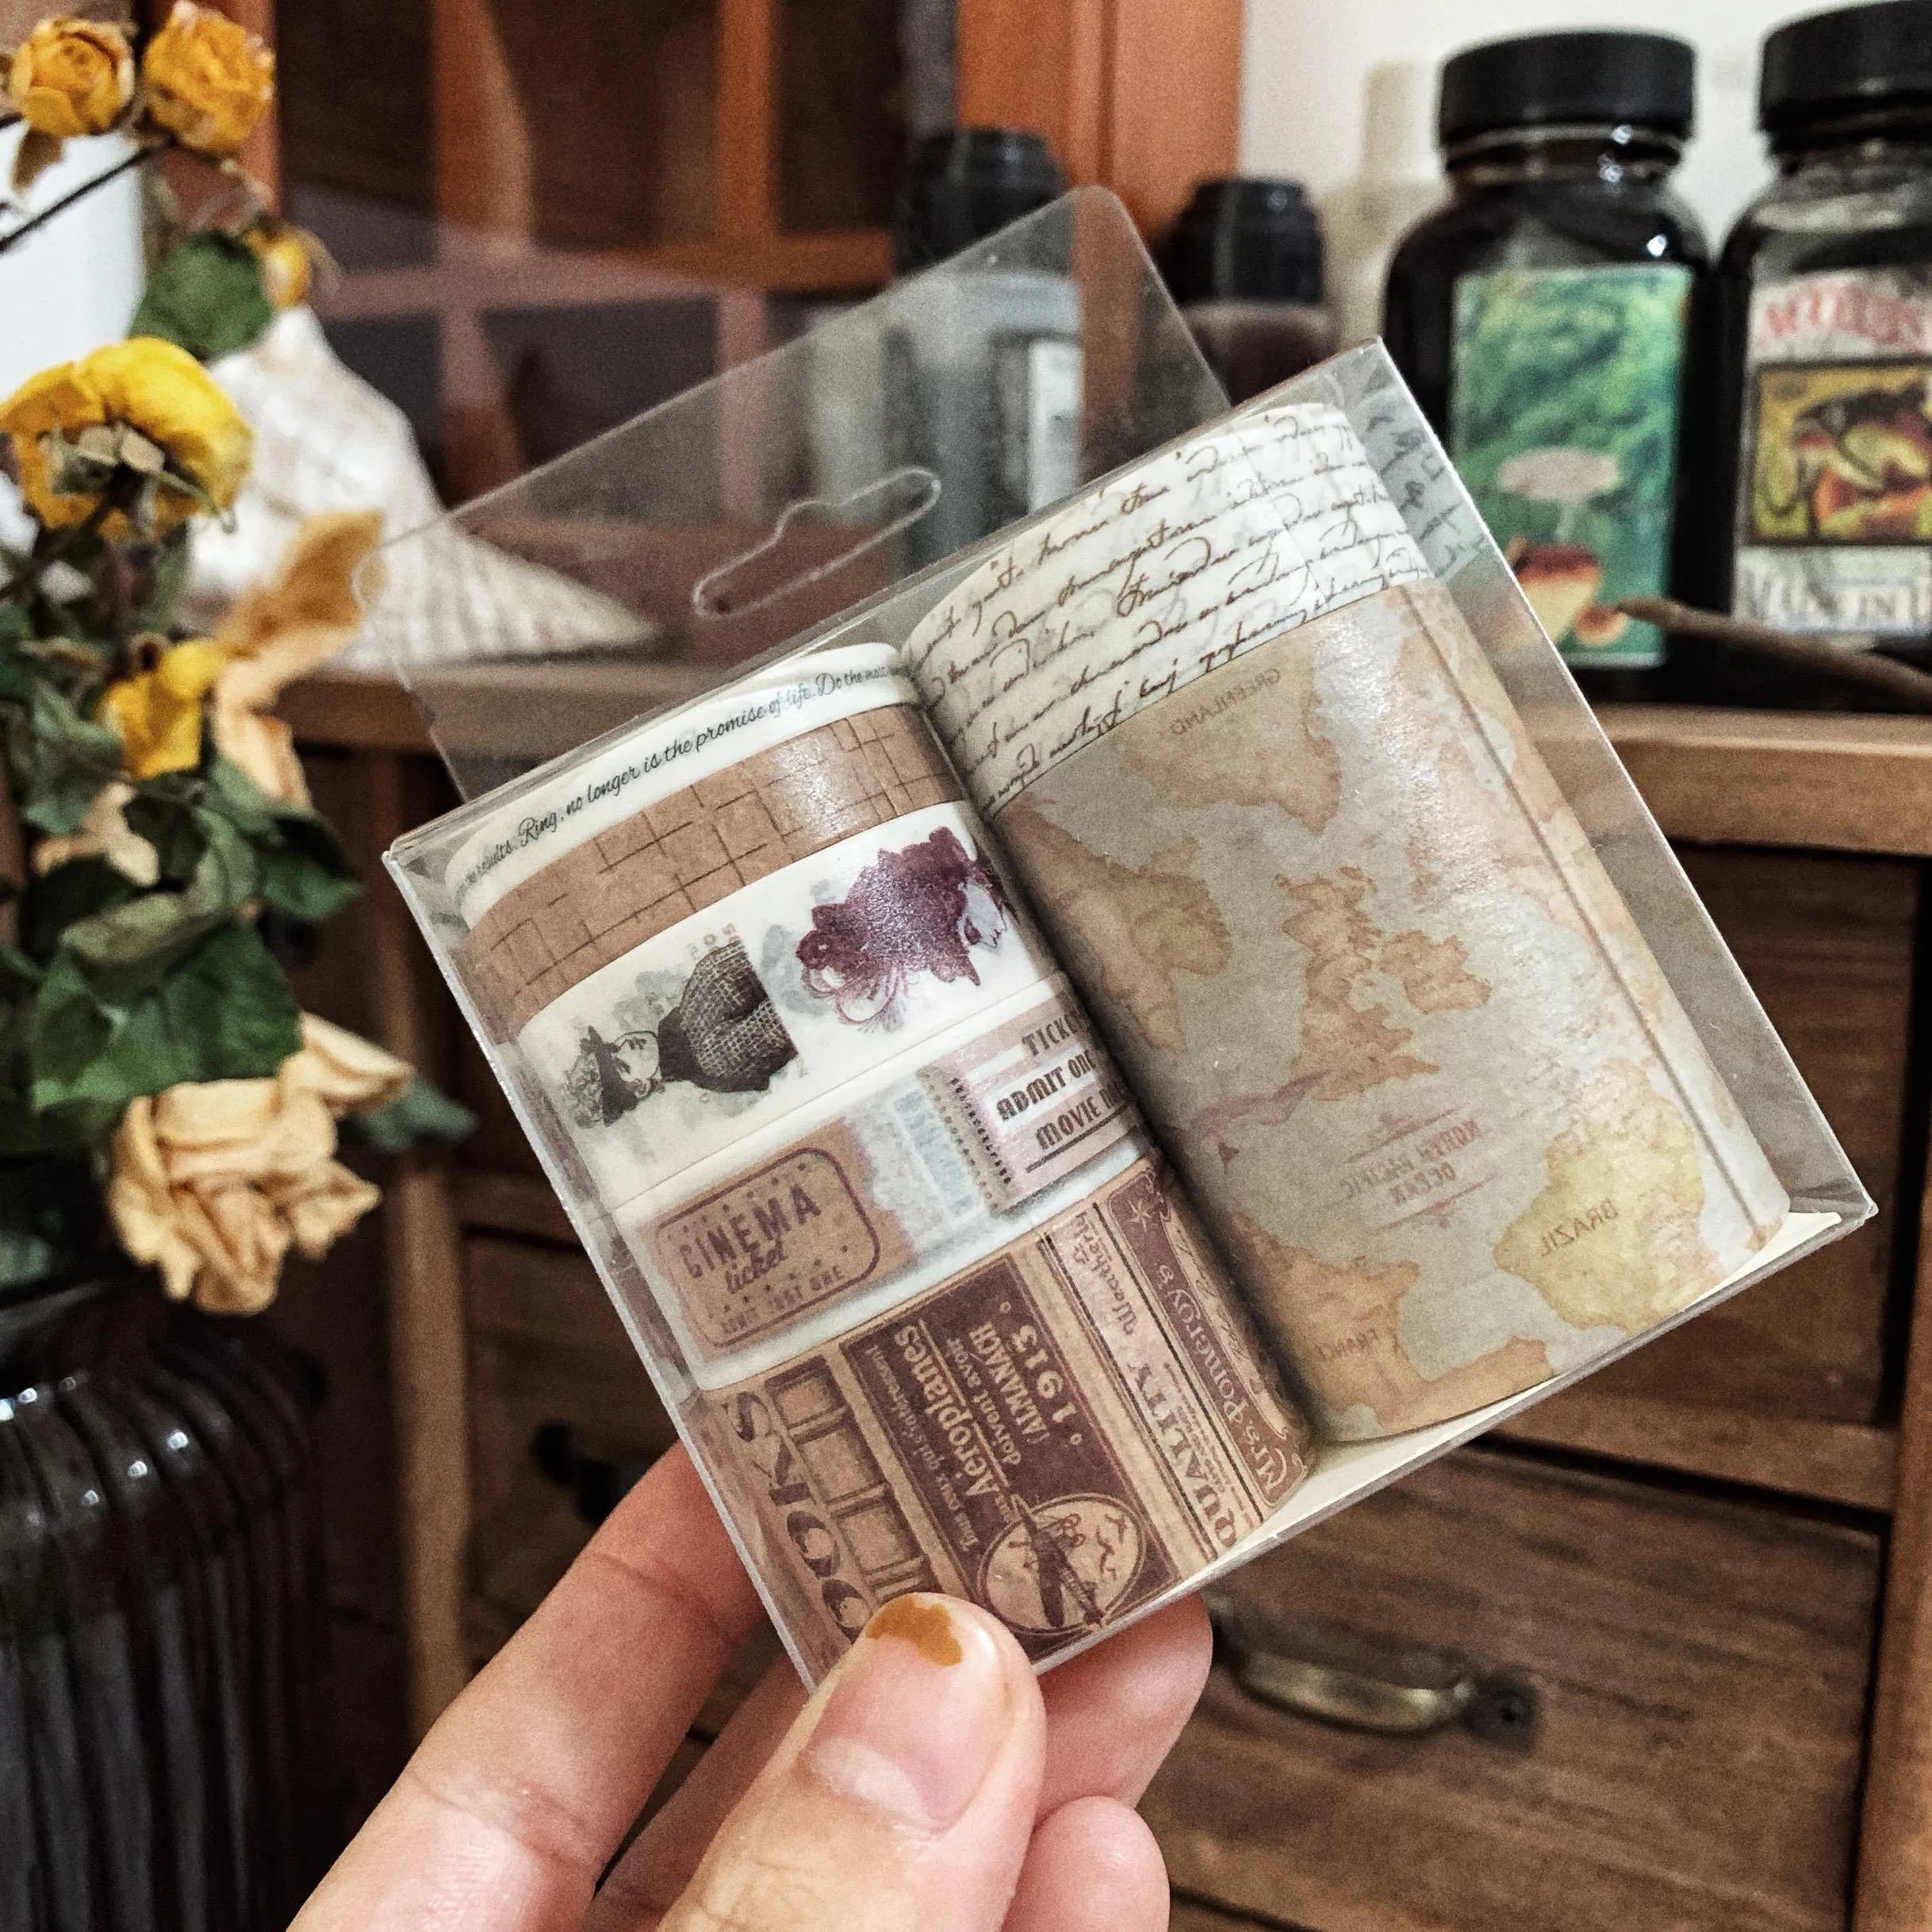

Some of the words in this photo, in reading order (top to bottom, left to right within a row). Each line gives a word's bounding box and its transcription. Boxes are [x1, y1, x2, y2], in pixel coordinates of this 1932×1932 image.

[566, 795, 583, 815] no
[588, 765, 640, 803] longer
[643, 752, 663, 772] is
[664, 734, 694, 763] the
[695, 705, 765, 753] promise
[768, 691, 783, 719] of
[815, 672, 843, 697] Do
[843, 671, 864, 688] the
[996, 1066, 1068, 1121] ADMIT
[1035, 1095, 1102, 1152] MOVIE
[678, 1183, 822, 1280] CINEMA
[724, 1234, 789, 1295] ticket
[1073, 1210, 1138, 1336] Weatherly
[945, 1336, 983, 1389] avoir
[1011, 1324, 1077, 1424] 1913
[1156, 1263, 1245, 1425] Pomeroy's
[893, 1324, 1001, 1497] Aéroplanes
[972, 1390, 1022, 1466] doivent
[1127, 1359, 1238, 1549] QUALITY
[1244, 1420, 1287, 1491] Mrs.
[720, 1390, 872, 1646] OOKS
